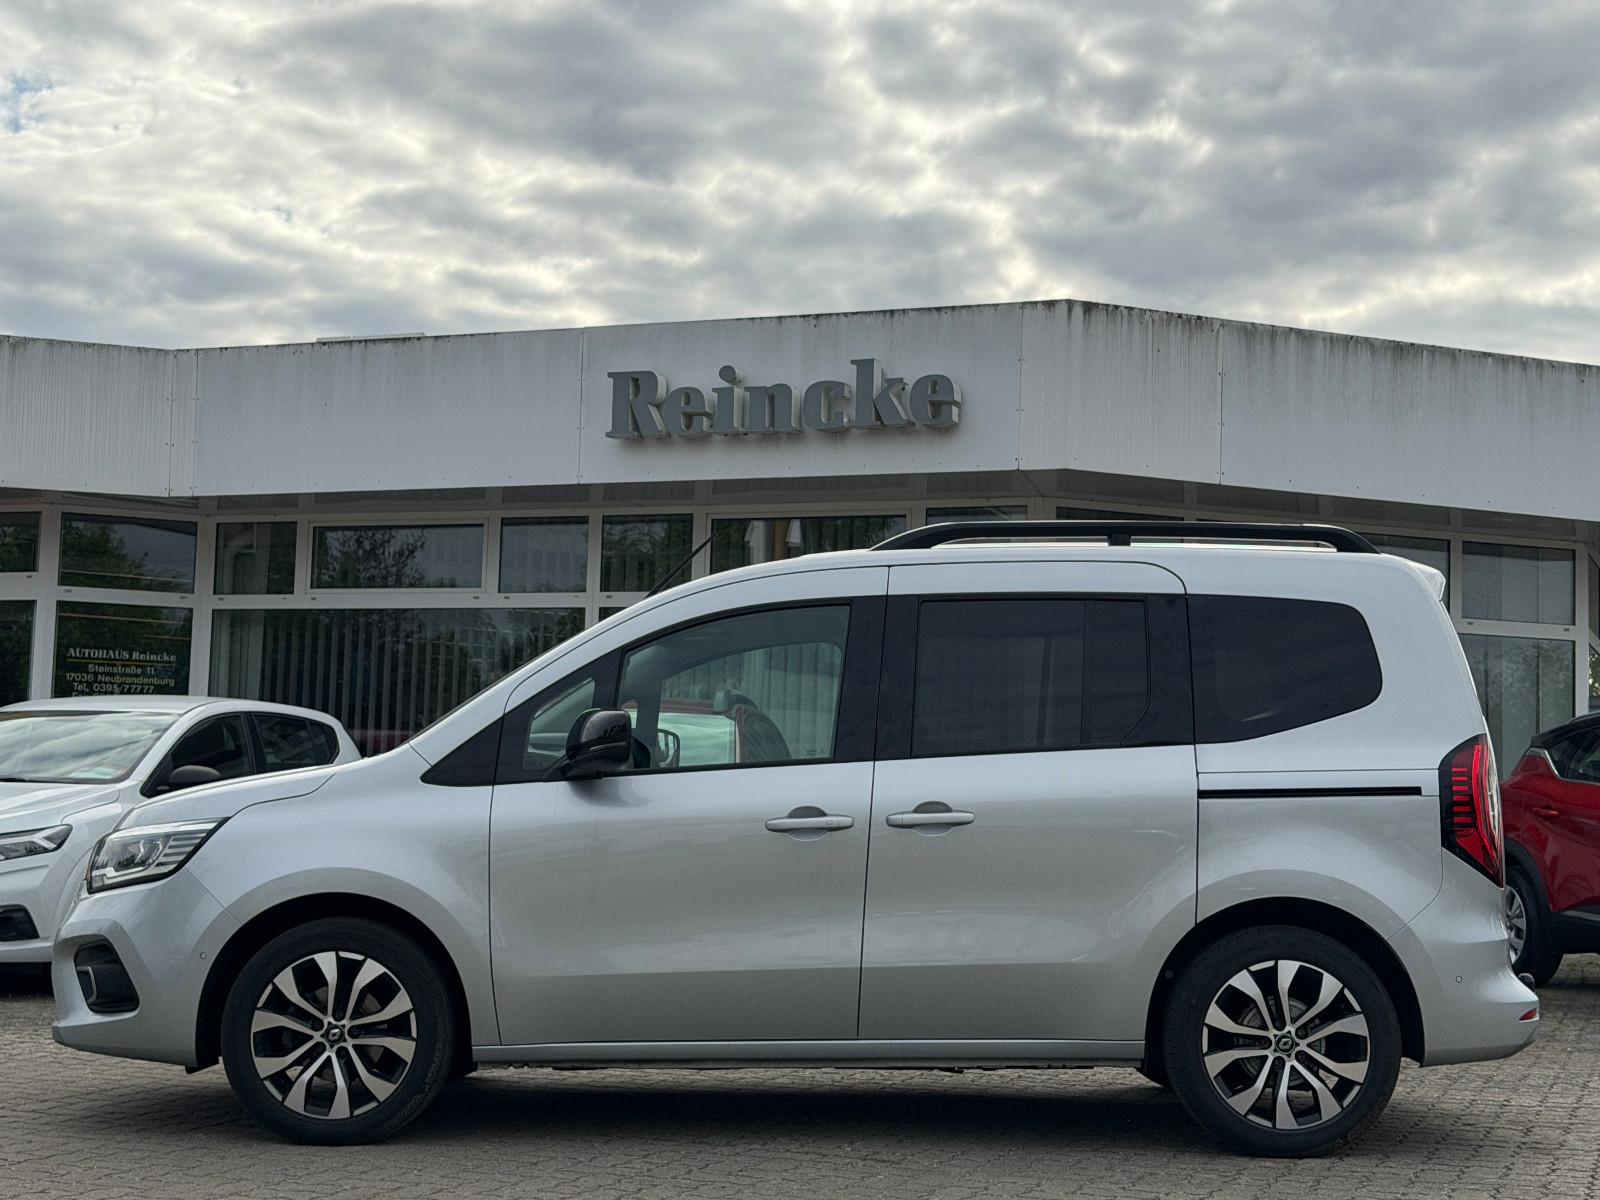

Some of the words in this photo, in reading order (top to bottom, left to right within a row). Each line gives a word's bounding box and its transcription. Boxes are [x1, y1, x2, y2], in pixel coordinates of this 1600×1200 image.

[605, 358, 962, 440] Reincke
[67, 648, 129, 659] AUTOHAUS
[132, 651, 177, 661] Reincke
[88, 664, 142, 674] Steinstraße
[97, 674, 175, 686] Neubrandenburg
